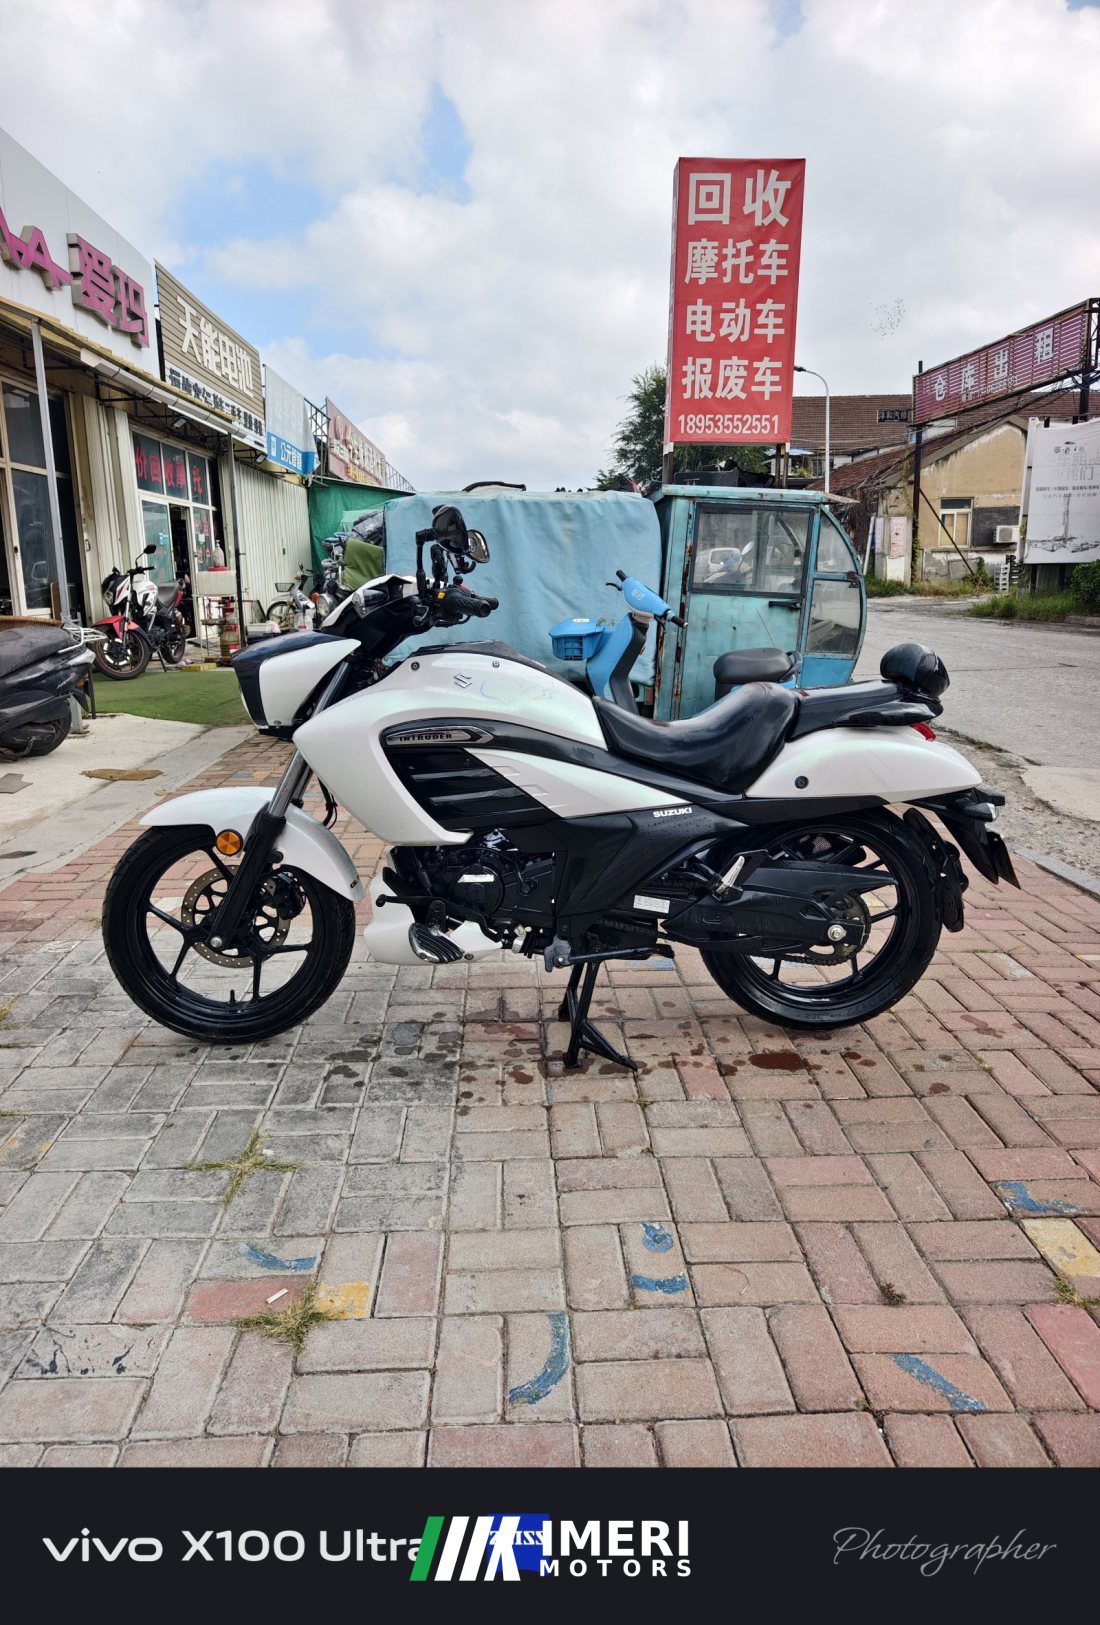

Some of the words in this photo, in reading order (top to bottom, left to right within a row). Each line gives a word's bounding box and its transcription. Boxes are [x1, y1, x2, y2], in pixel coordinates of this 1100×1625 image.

[687, 168, 791, 227] 回收
[684, 238, 790, 285] 摩托车
[67, 232, 149, 348] 爱玛
[685, 298, 786, 344] 电动车
[176, 295, 254, 398] 天能电池
[681, 355, 783, 401] 报废车
[678, 414, 779, 434] 18953552551
[399, 733, 453, 742] INTRUDER
[653, 807, 693, 818] SUZUKI
